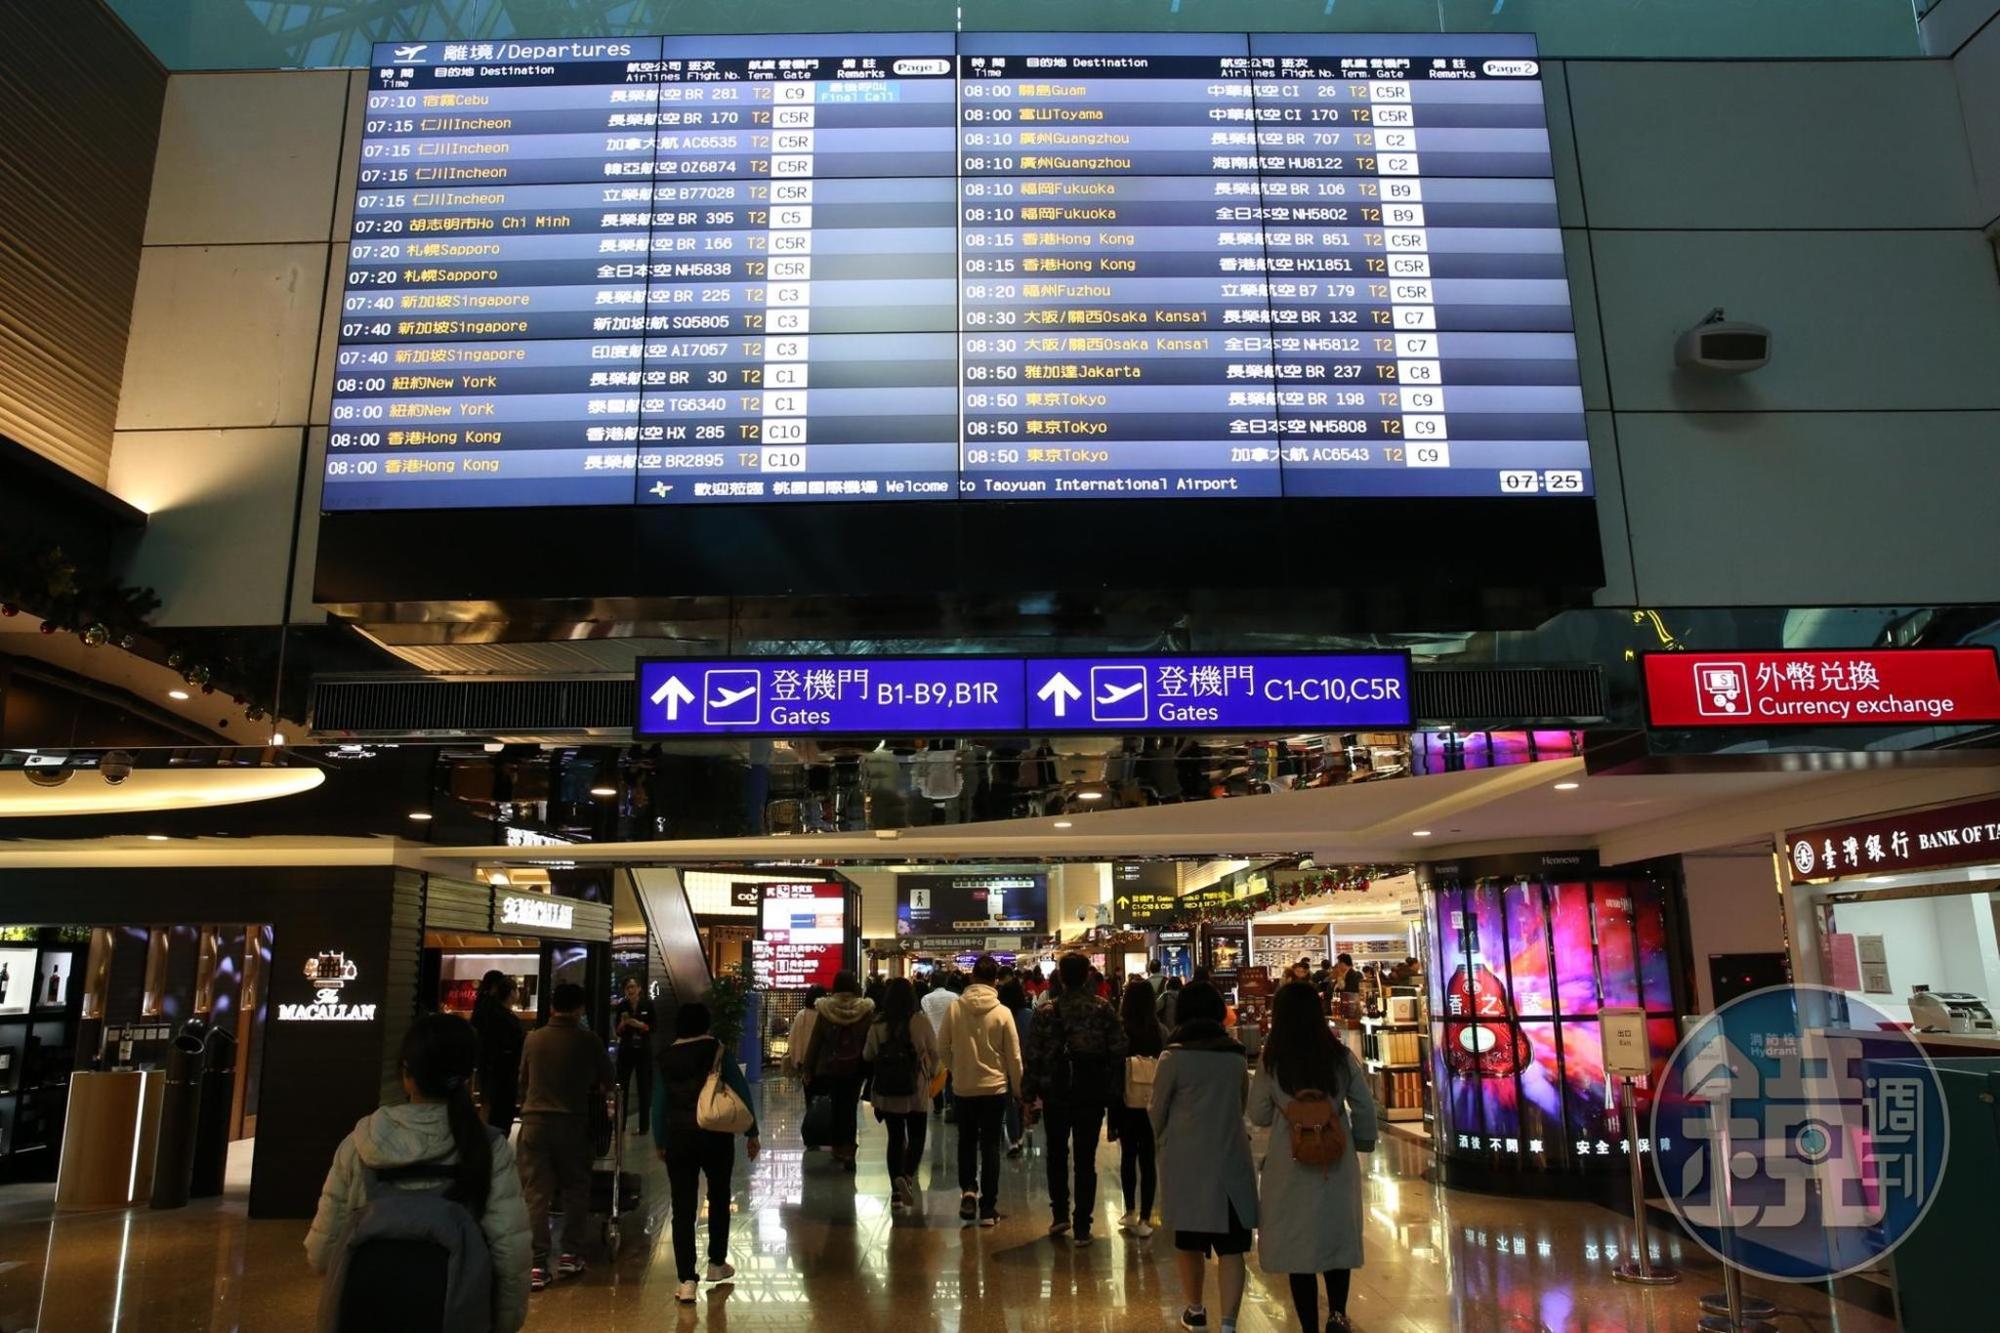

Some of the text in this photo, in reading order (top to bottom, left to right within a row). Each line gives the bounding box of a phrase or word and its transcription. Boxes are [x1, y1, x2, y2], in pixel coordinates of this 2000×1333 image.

[443, 43, 630, 61] 離境/Departures
[481, 65, 554, 76] Destination
[898, 63, 931, 74] Page
[1073, 58, 1148, 68] Destination
[1487, 63, 1533, 74] Page 2
[383, 79, 409, 88] Time
[687, 70, 721, 81] Flight
[724, 70, 741, 81] No.
[748, 70, 777, 80] Term.
[783, 70, 811, 80] Gate
[837, 69, 885, 79] Remarks
[975, 68, 1002, 78] Time
[1281, 68, 1315, 79] Flight
[1318, 69, 1335, 78] No.
[1342, 70, 1370, 78] Term.
[1377, 69, 1404, 79] Gate
[1429, 70, 1476, 79] Remarks
[370, 88, 804, 108] 07:10 C9
[965, 86, 1405, 98] 08:00 C5R
[367, 121, 413, 132] 07:15
[779, 112, 809, 124] C5R
[965, 110, 1012, 120] 08:00
[1379, 110, 1408, 122] C5R
[364, 136, 808, 157] 07:15 AC6535 C5R
[965, 134, 1405, 146] 08:10 C2
[361, 170, 408, 182] 07:15
[777, 161, 807, 173] C5R
[965, 158, 1408, 171] 08:10 HU8122 C2
[358, 186, 807, 208] 07:15 B77028 C5R
[965, 184, 1411, 197] 08:10 B9
[355, 212, 801, 233] 07:20 Chi Minh C5
[965, 209, 1013, 221] 08:10
[1292, 208, 1347, 220] NH5802
[1394, 210, 1413, 222] B9
[352, 238, 805, 258] 07:20 C5R
[965, 234, 1421, 247] 08:15 C5R
[349, 272, 397, 284] 07:20
[675, 264, 732, 277] NH5838
[773, 263, 804, 275] C5R
[966, 259, 1424, 272] 08:15 HX1851 C5R
[346, 289, 799, 310] 07:40 C3
[966, 285, 1427, 298] 08:20 C5R
[343, 323, 391, 336] 07:40
[672, 316, 729, 328] SQ5805
[777, 316, 798, 328] C3
[966, 312, 1016, 324] 08:30
[1156, 311, 1207, 323] Kansai
[1405, 312, 1425, 324] C7
[340, 343, 797, 364] 07:40 AI7057 C3
[967, 338, 1427, 352] 08:30 NH5812 C7
[337, 378, 385, 391] 08:00
[462, 375, 496, 388] York
[776, 370, 796, 383] C1
[967, 366, 1017, 379] 08:50
[1410, 366, 1430, 379] C8
[334, 398, 795, 419] 08:00 TG6340 C1
[967, 394, 1433, 407] 08:50 C9
[331, 434, 380, 447] 08:00
[465, 430, 501, 445] Kong
[768, 426, 800, 439] C10
[967, 422, 1018, 435] 08:50
[1310, 420, 1367, 433] NH5808
[1415, 421, 1435, 434] C9
[328, 454, 799, 475] 08:00 BR2895 C10
[968, 448, 1438, 464] 08:50 AC6543 C9
[886, 480, 948, 494] Welcome
[960, 480, 975, 491] to
[985, 479, 1046, 492] Taoyuan
[1055, 478, 1167, 490] International
[1177, 478, 1238, 492] Airport
[1506, 475, 1578, 489] 07:25
[770, 668, 998, 708] 登機門 B1-B9,B1R
[1156, 664, 1401, 704] 登機門 C1-C10,C5R
[1158, 703, 1219, 721] Gates
[1758, 694, 1954, 719] Currency exchange
[770, 707, 831, 725] Gates
[1821, 830, 1910, 870] 臺灣銀行
[1919, 830, 1960, 850] BANK
[1962, 825, 1983, 844] OF
[277, 1003, 376, 1021] MACALLAN
[1750, 1046, 1798, 1058] Hydrant
